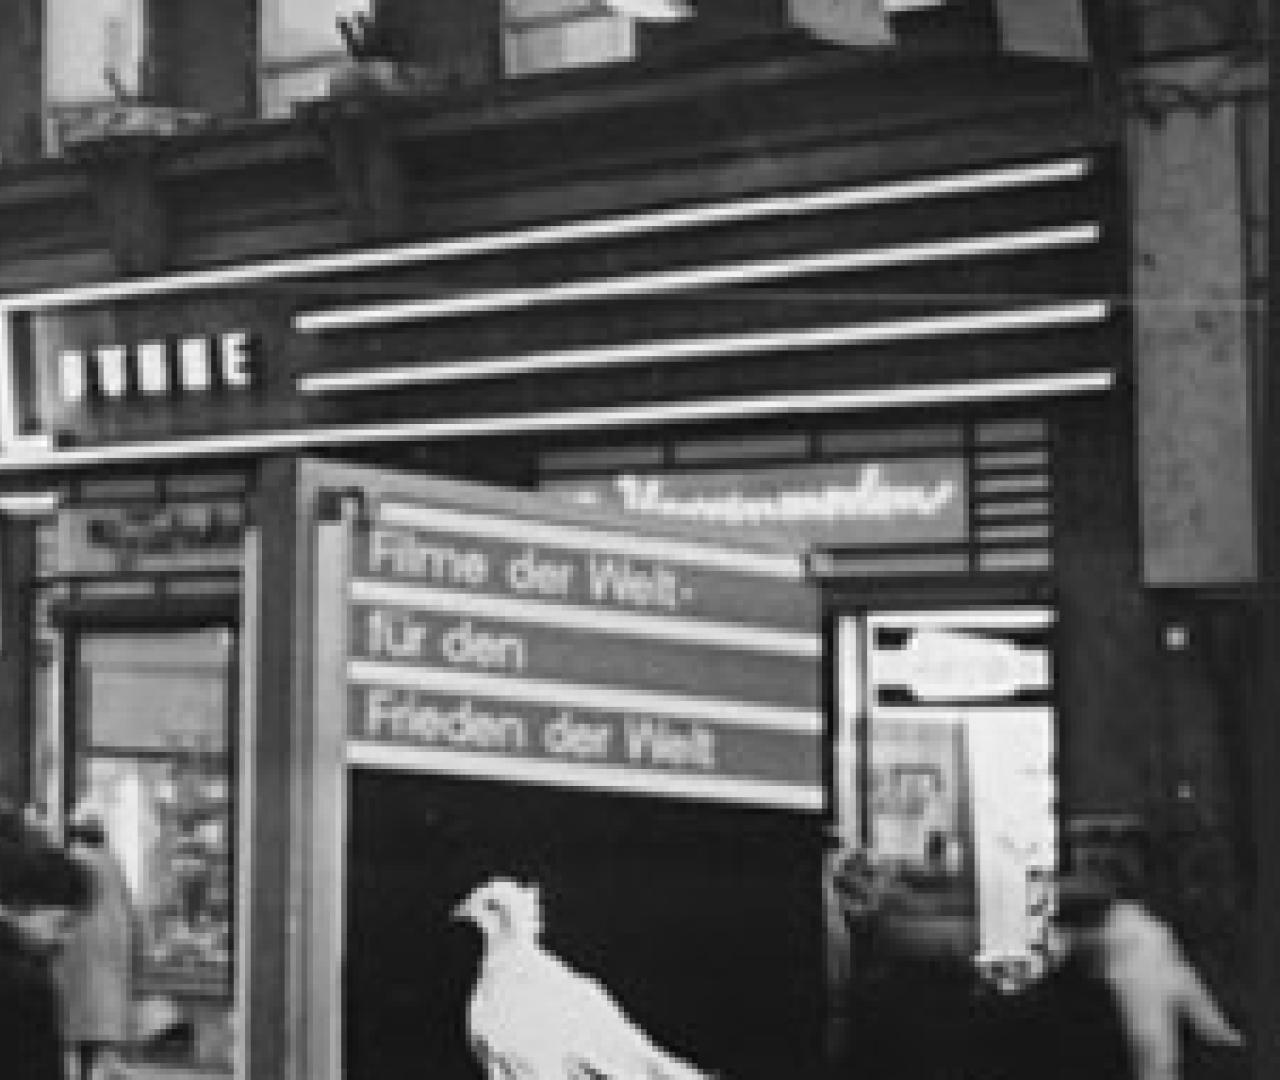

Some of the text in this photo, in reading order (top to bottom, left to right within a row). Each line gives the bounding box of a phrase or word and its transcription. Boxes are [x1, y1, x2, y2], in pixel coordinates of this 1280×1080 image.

[369, 529, 490, 585] Filme
[508, 544, 574, 598] der
[442, 619, 527, 672] den
[368, 687, 717, 772] Frieden der Welt
